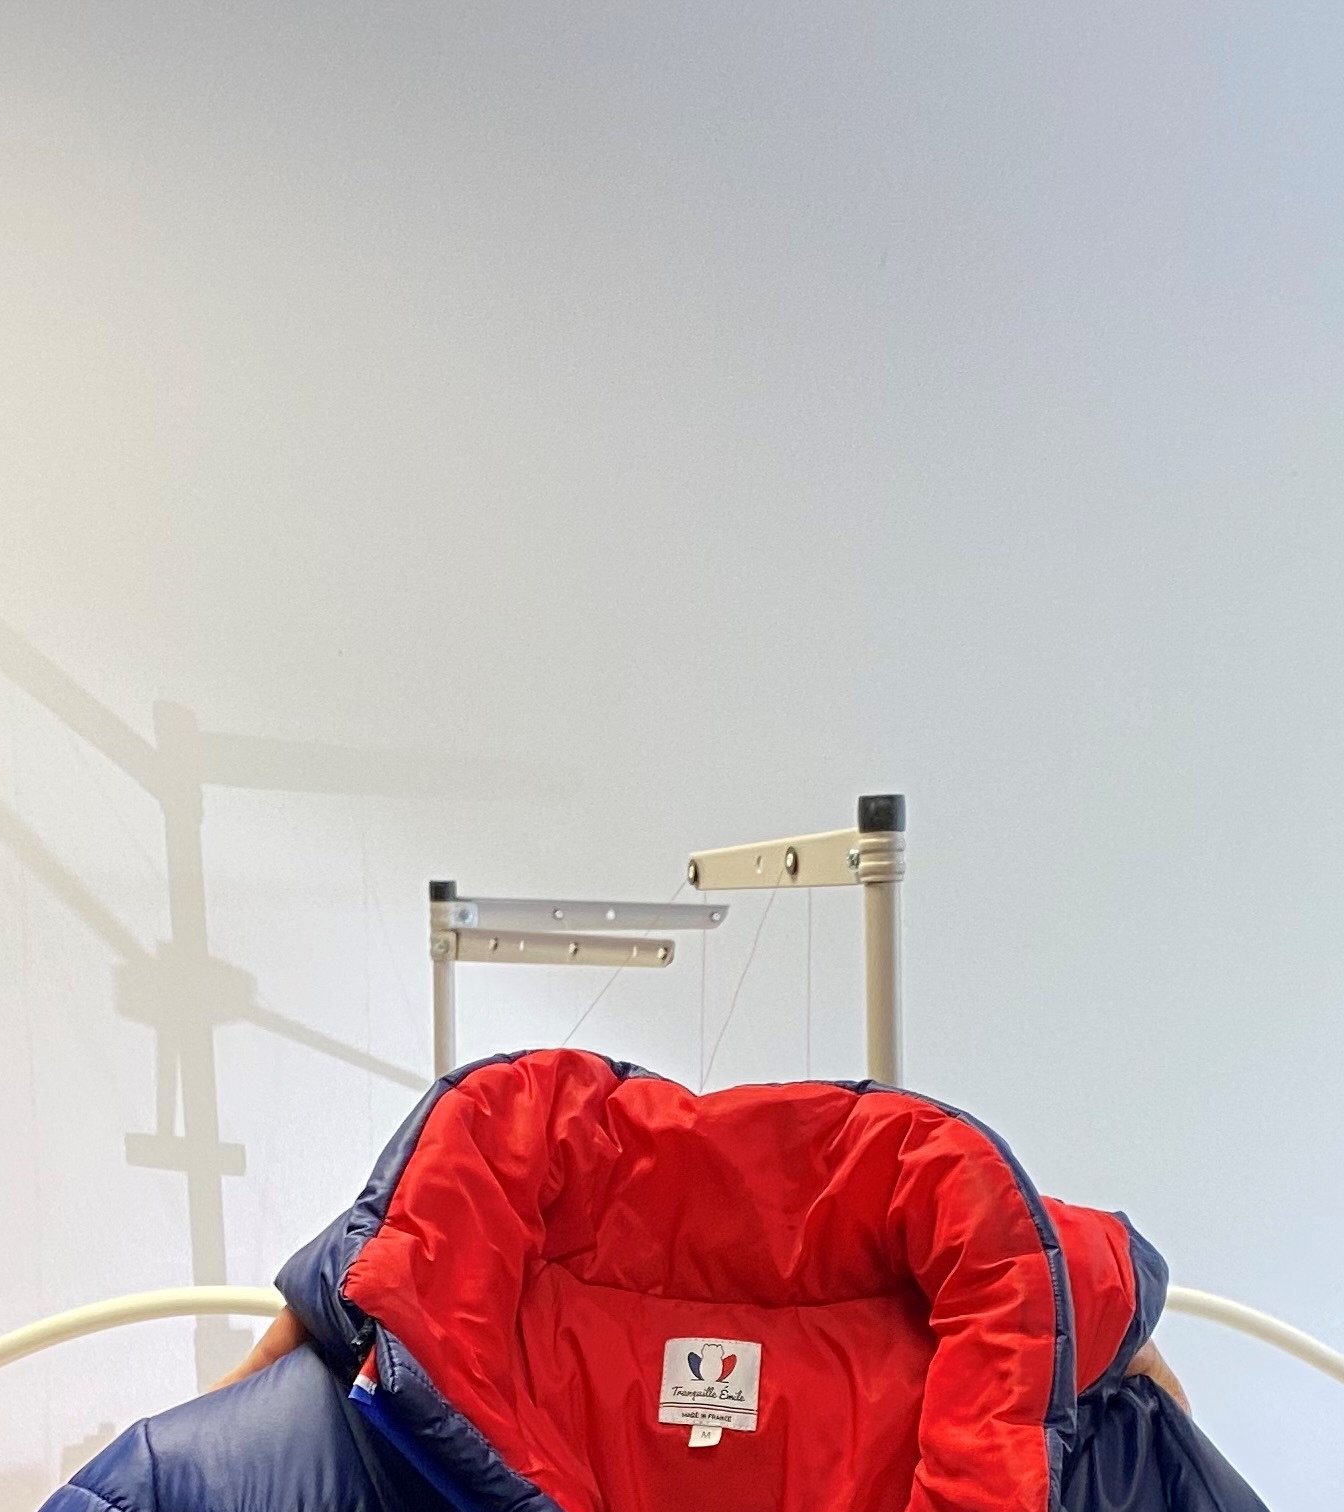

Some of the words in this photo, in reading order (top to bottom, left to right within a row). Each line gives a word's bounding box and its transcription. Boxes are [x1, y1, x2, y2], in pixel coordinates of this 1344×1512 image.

[672, 1386, 717, 1401] Tranquille
[719, 1385, 745, 1402] Émile
[708, 1413, 732, 1422] FRANCE
[701, 1431, 711, 1439] M
